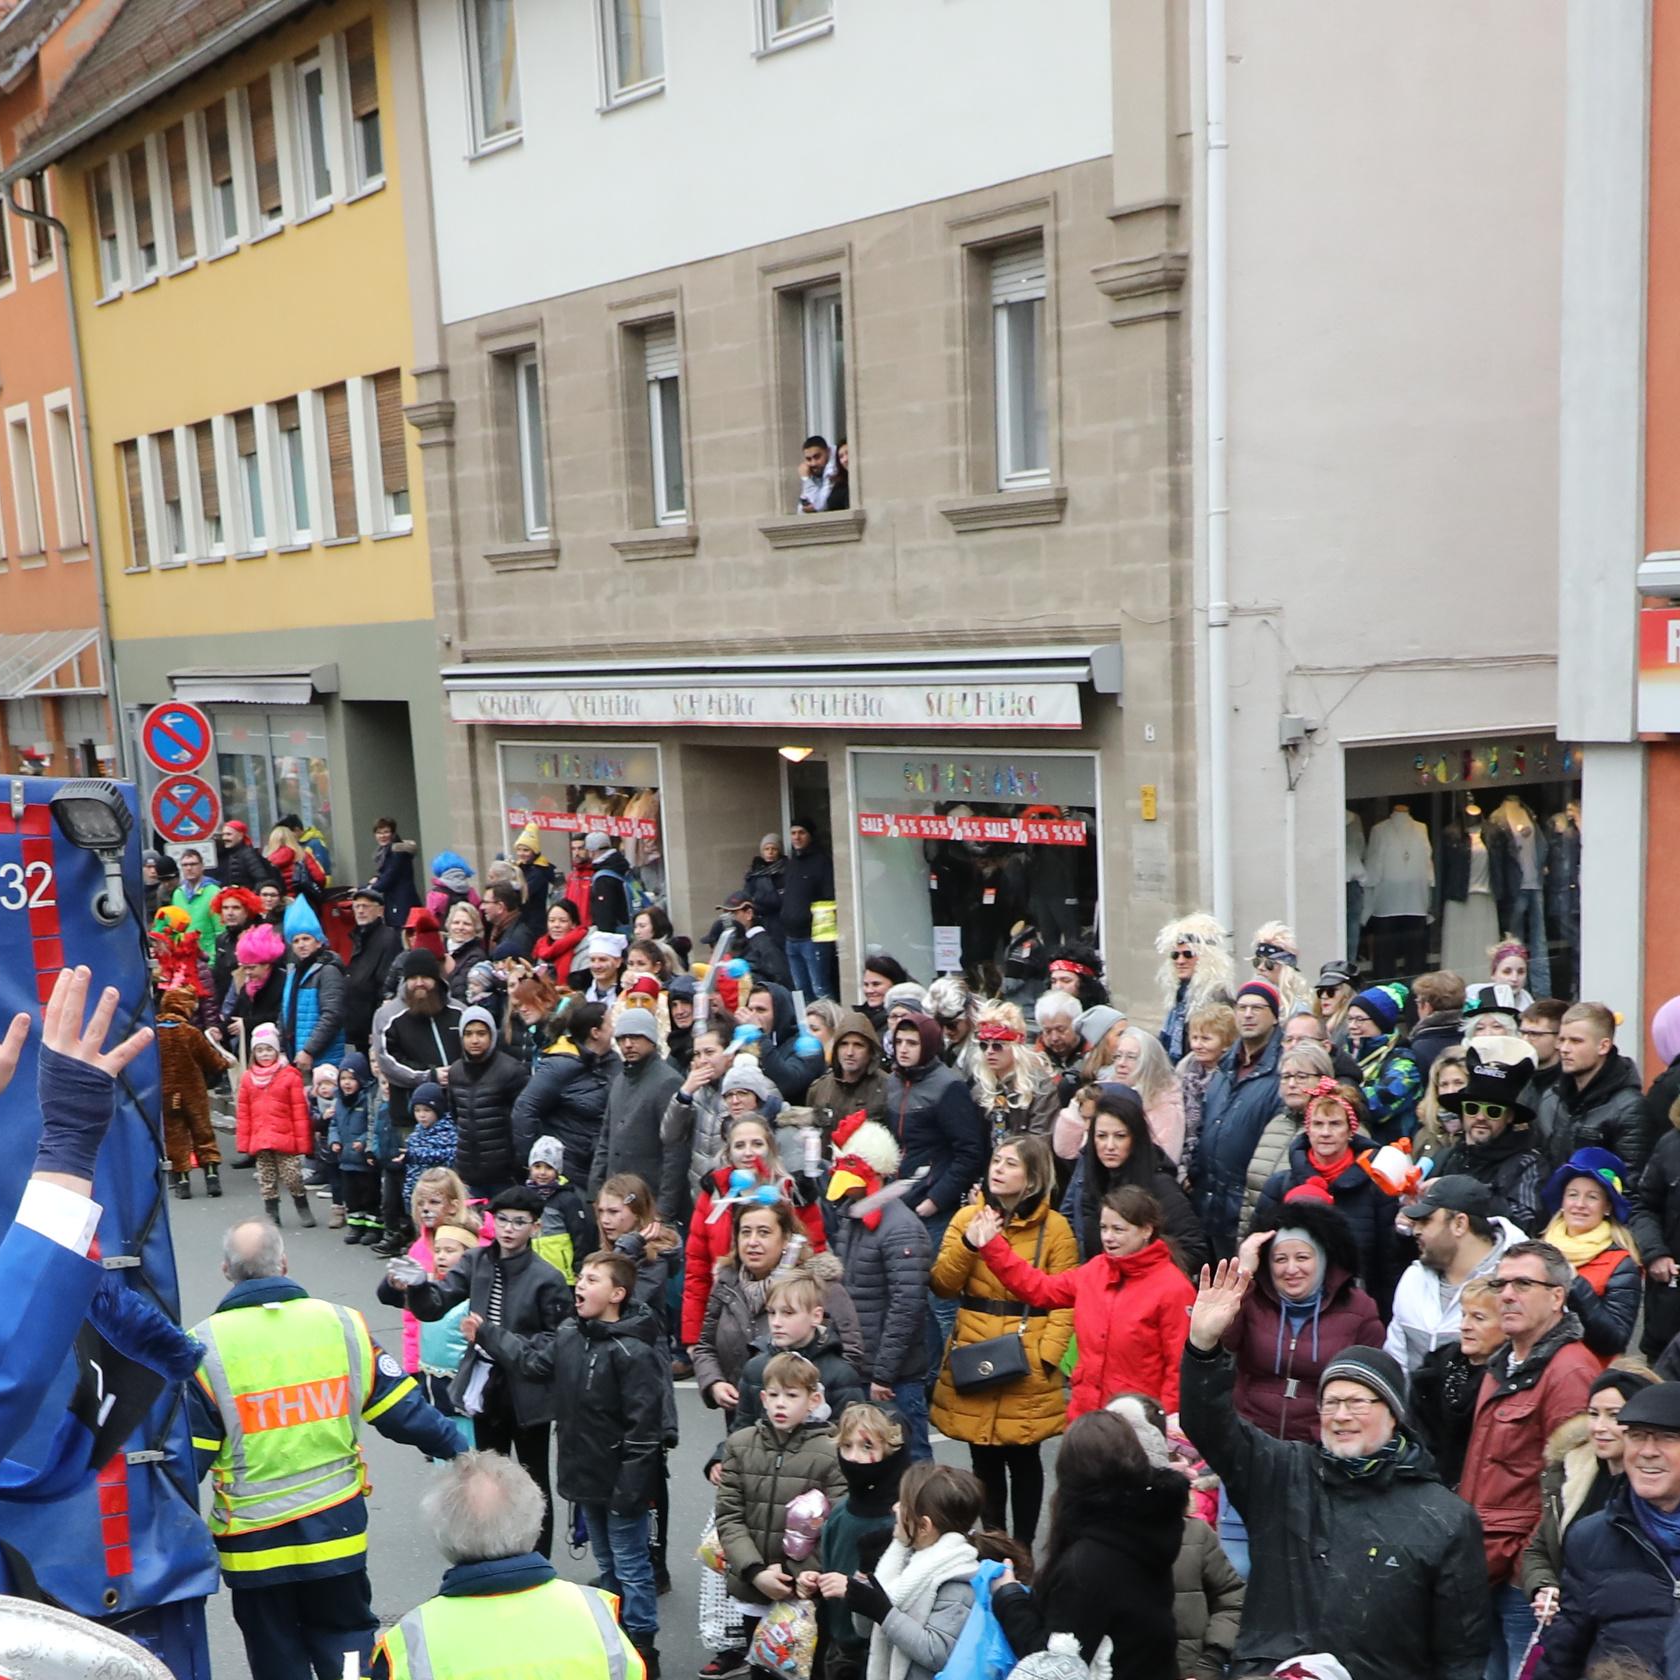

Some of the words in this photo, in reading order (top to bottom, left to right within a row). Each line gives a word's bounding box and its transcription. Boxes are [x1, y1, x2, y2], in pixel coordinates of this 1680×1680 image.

[861, 817, 884, 832] SALE
[984, 821, 1010, 838] SALE
[245, 1380, 346, 1428] THW
